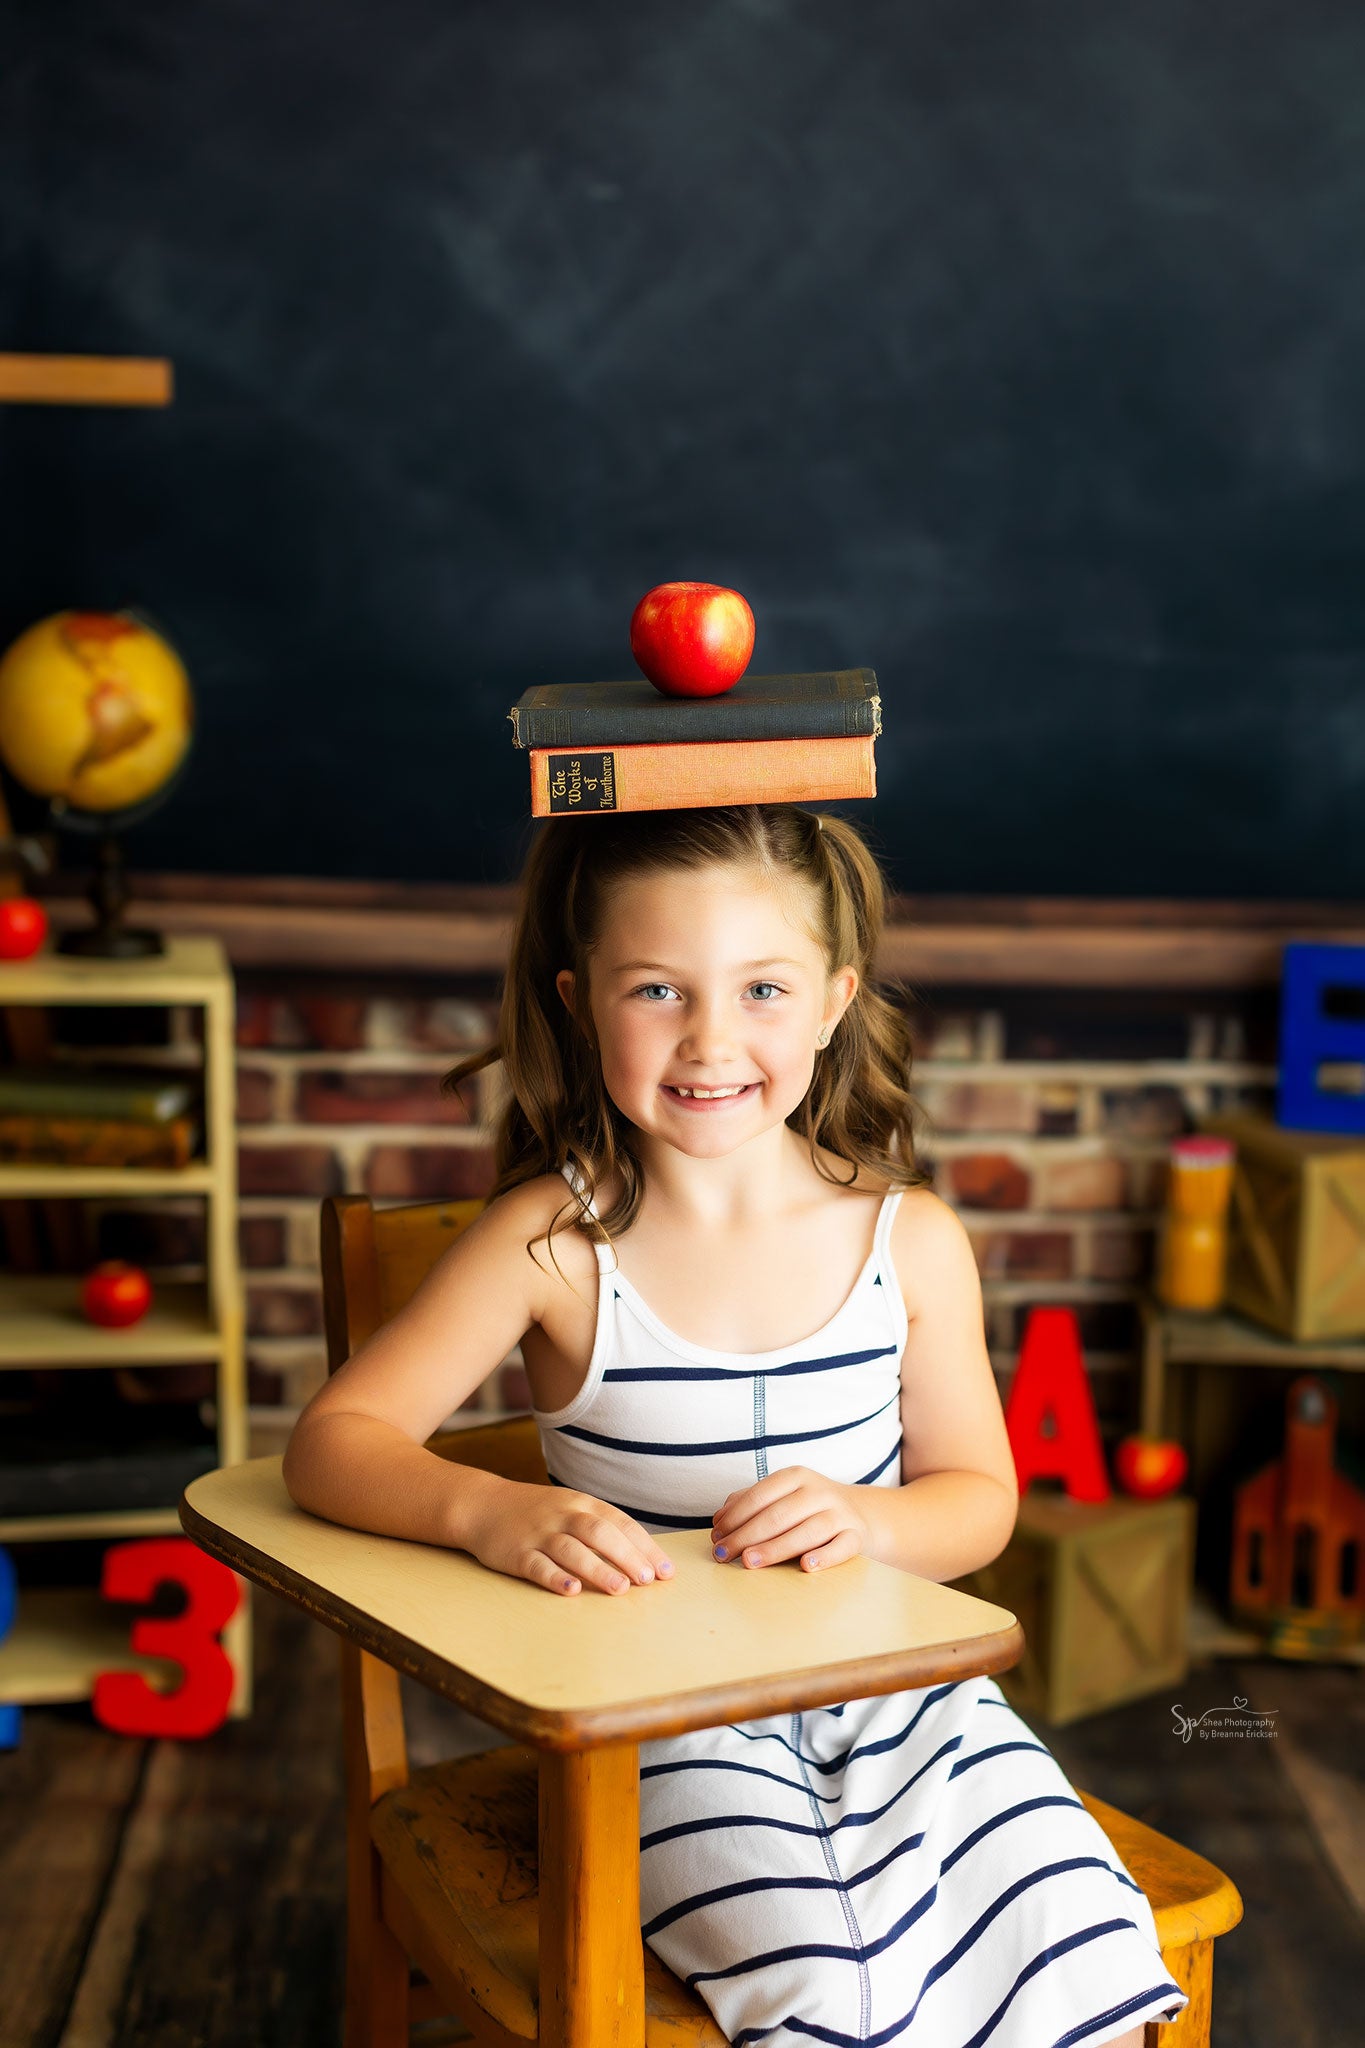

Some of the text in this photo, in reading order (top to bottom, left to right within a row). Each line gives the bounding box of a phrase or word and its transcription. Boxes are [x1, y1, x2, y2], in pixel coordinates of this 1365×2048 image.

[552, 770, 566, 799] The
[568, 761, 581, 805] Works
[584, 776, 598, 791] of
[600, 755, 614, 808] Hawthorne
[1004, 1305, 1111, 1503] A
[92, 1536, 241, 1739] 3
